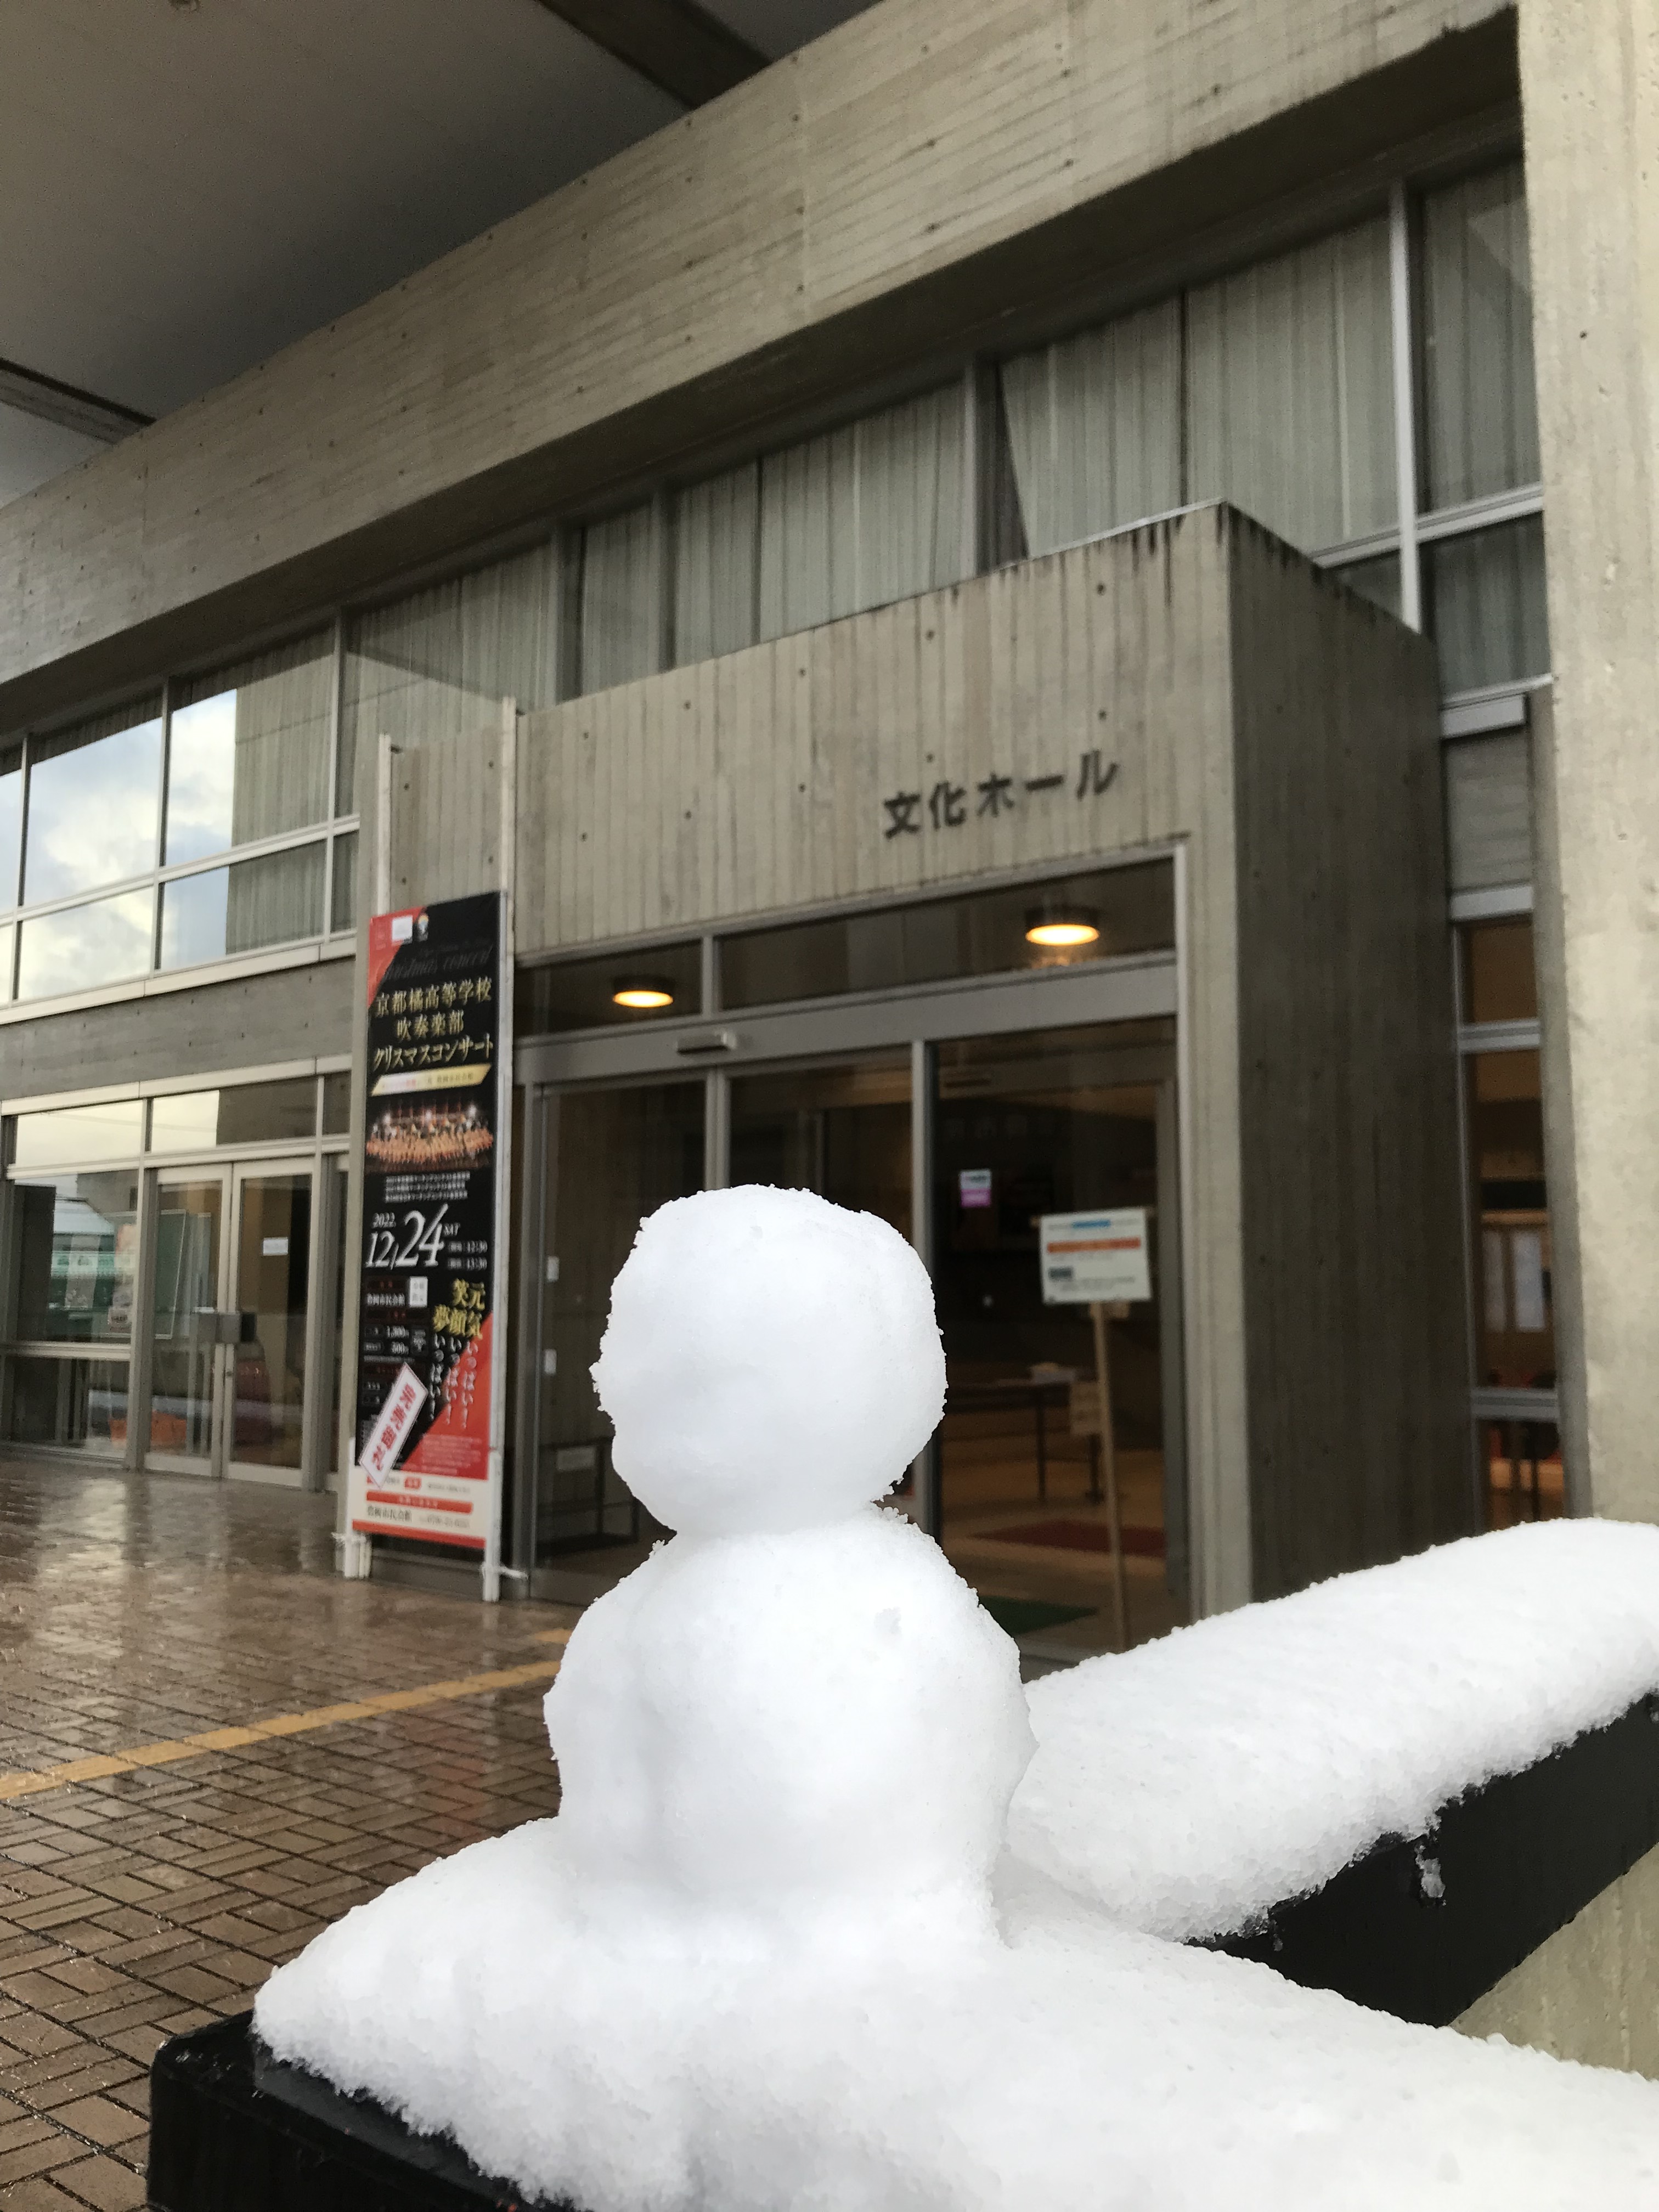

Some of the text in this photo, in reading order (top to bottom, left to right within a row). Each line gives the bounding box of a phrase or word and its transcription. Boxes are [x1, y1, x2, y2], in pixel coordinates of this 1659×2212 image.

[883, 748, 1120, 841] 文化ホール
[372, 1032, 494, 1071] クリスマスコンサート
[372, 1382, 416, 1471] 完売御礼
